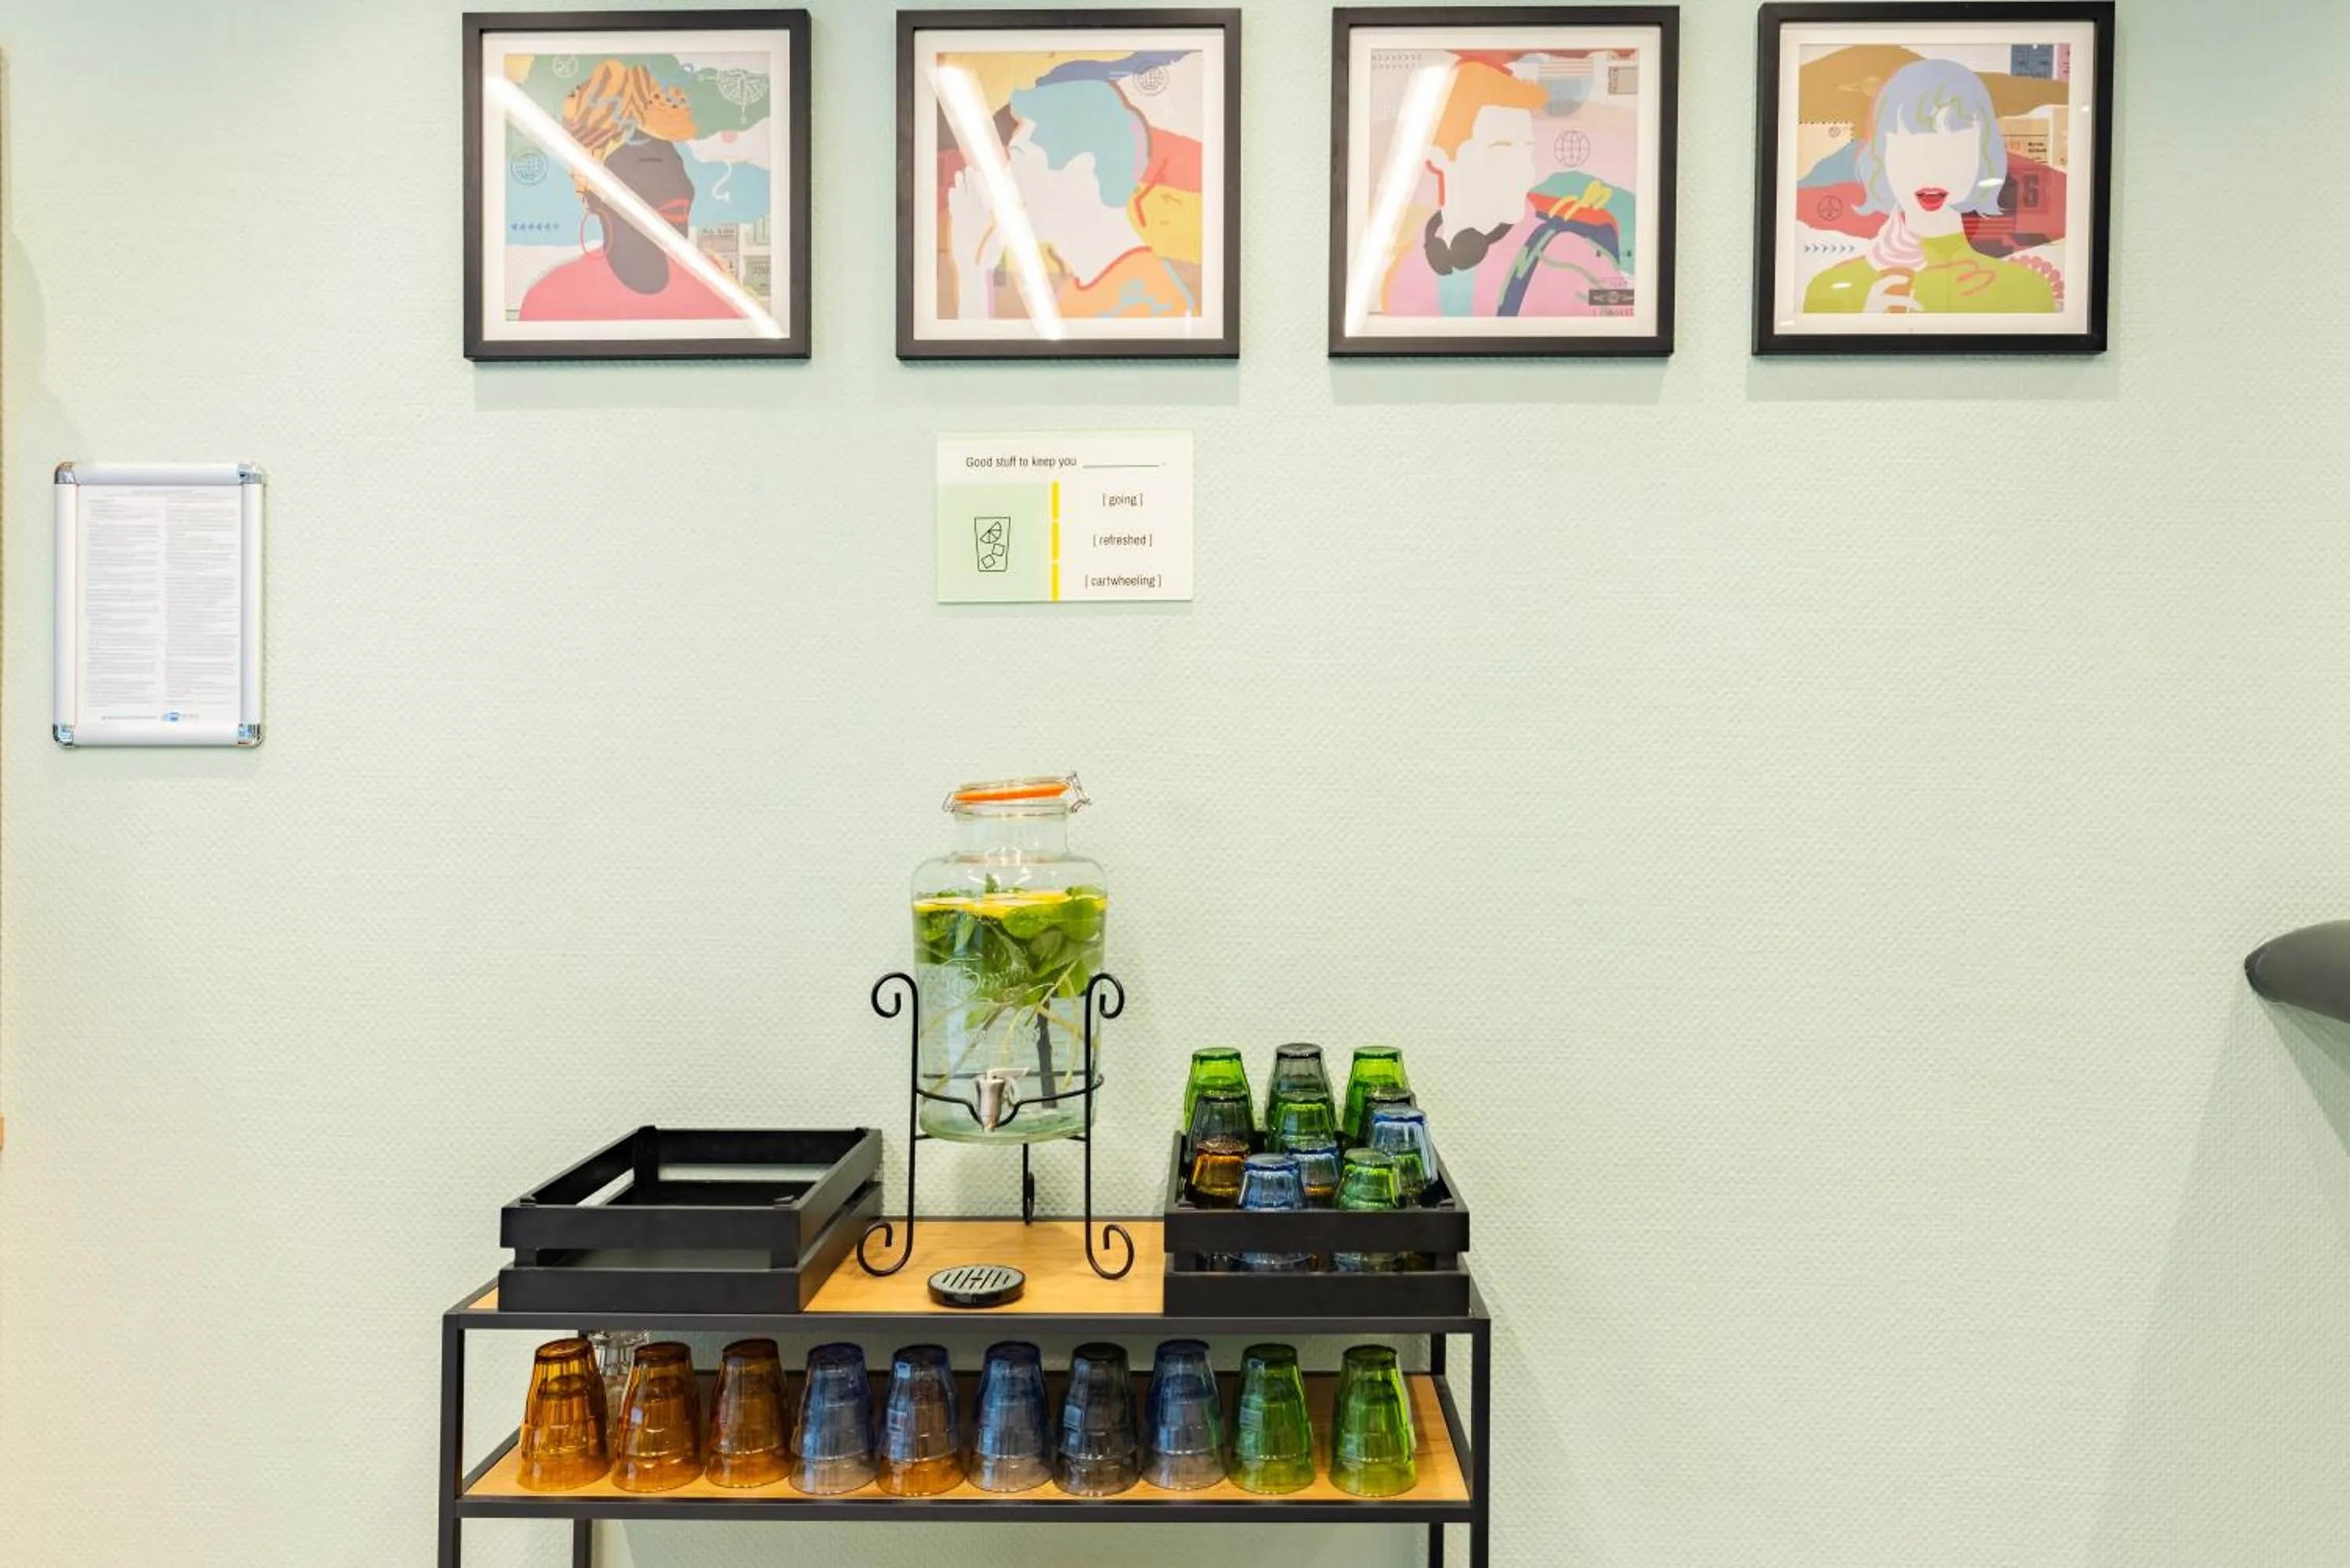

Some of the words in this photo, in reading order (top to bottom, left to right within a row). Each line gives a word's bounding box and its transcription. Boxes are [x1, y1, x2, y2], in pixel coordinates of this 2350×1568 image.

[966, 457, 992, 468] Good
[996, 456, 1016, 468] stuff
[1019, 457, 1029, 468] to
[1032, 455, 1056, 469] keep
[1058, 456, 1077, 469] you
[1108, 493, 1137, 507] going
[1099, 534, 1146, 546] refreshed
[1091, 574, 1155, 587] cartwheeling
